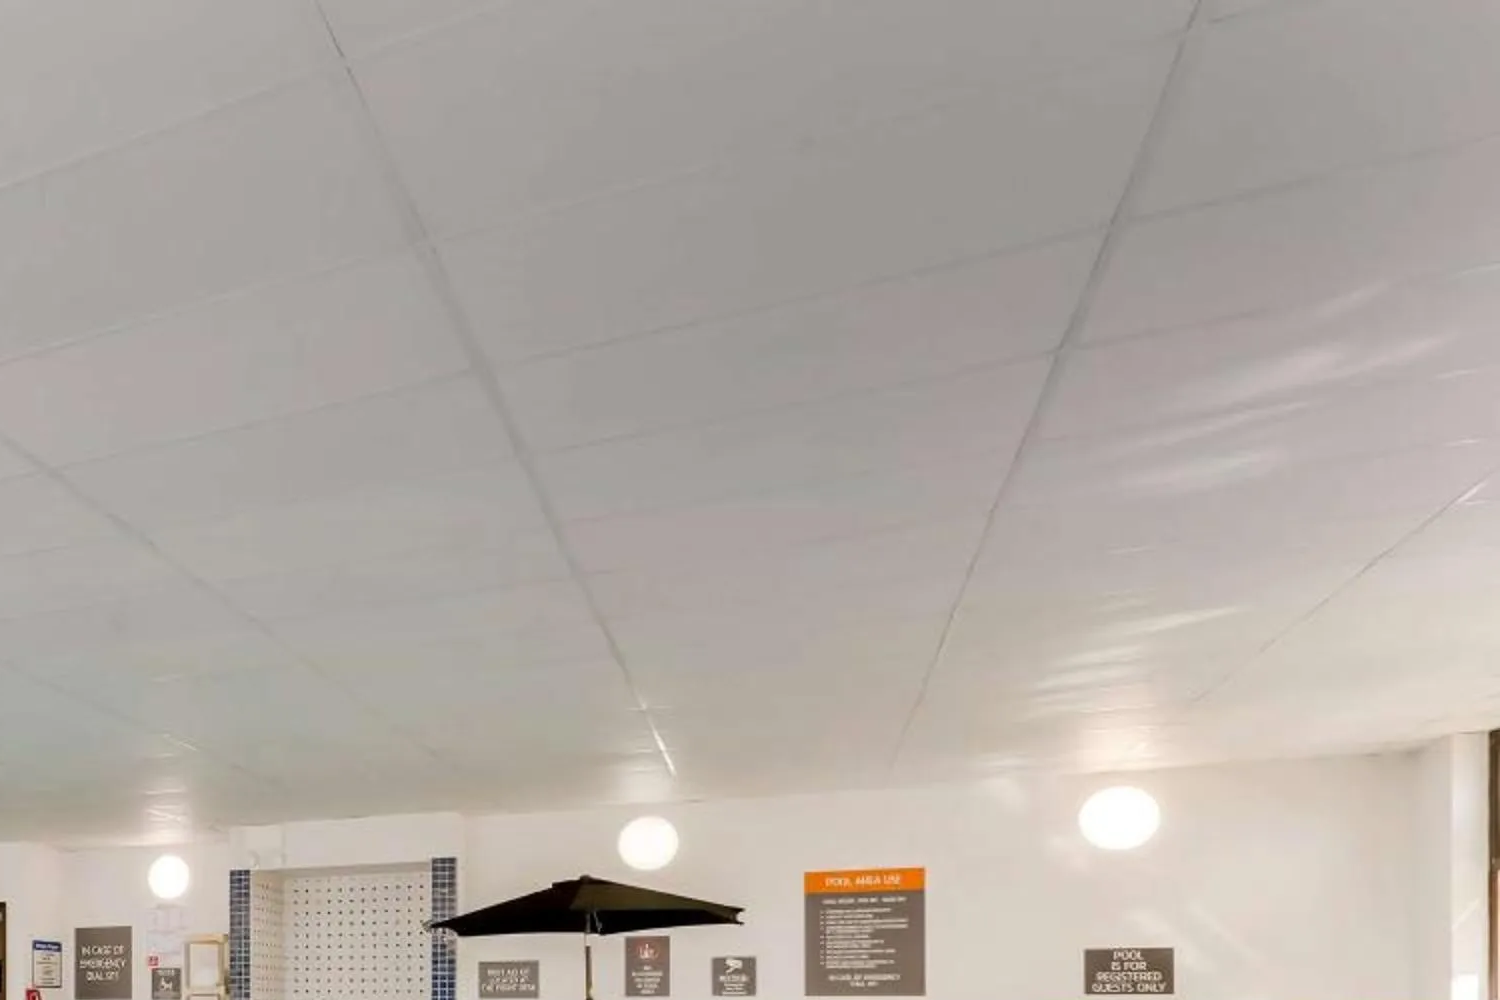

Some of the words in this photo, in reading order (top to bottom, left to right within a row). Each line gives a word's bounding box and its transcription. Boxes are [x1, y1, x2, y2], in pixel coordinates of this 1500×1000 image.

[1113, 949, 1144, 961] POOL
[1123, 961, 1147, 971] FOR
[1096, 971, 1162, 982] REGISTERED
[1091, 982, 1135, 993] GUESTS
[1137, 982, 1166, 993] ONLY
